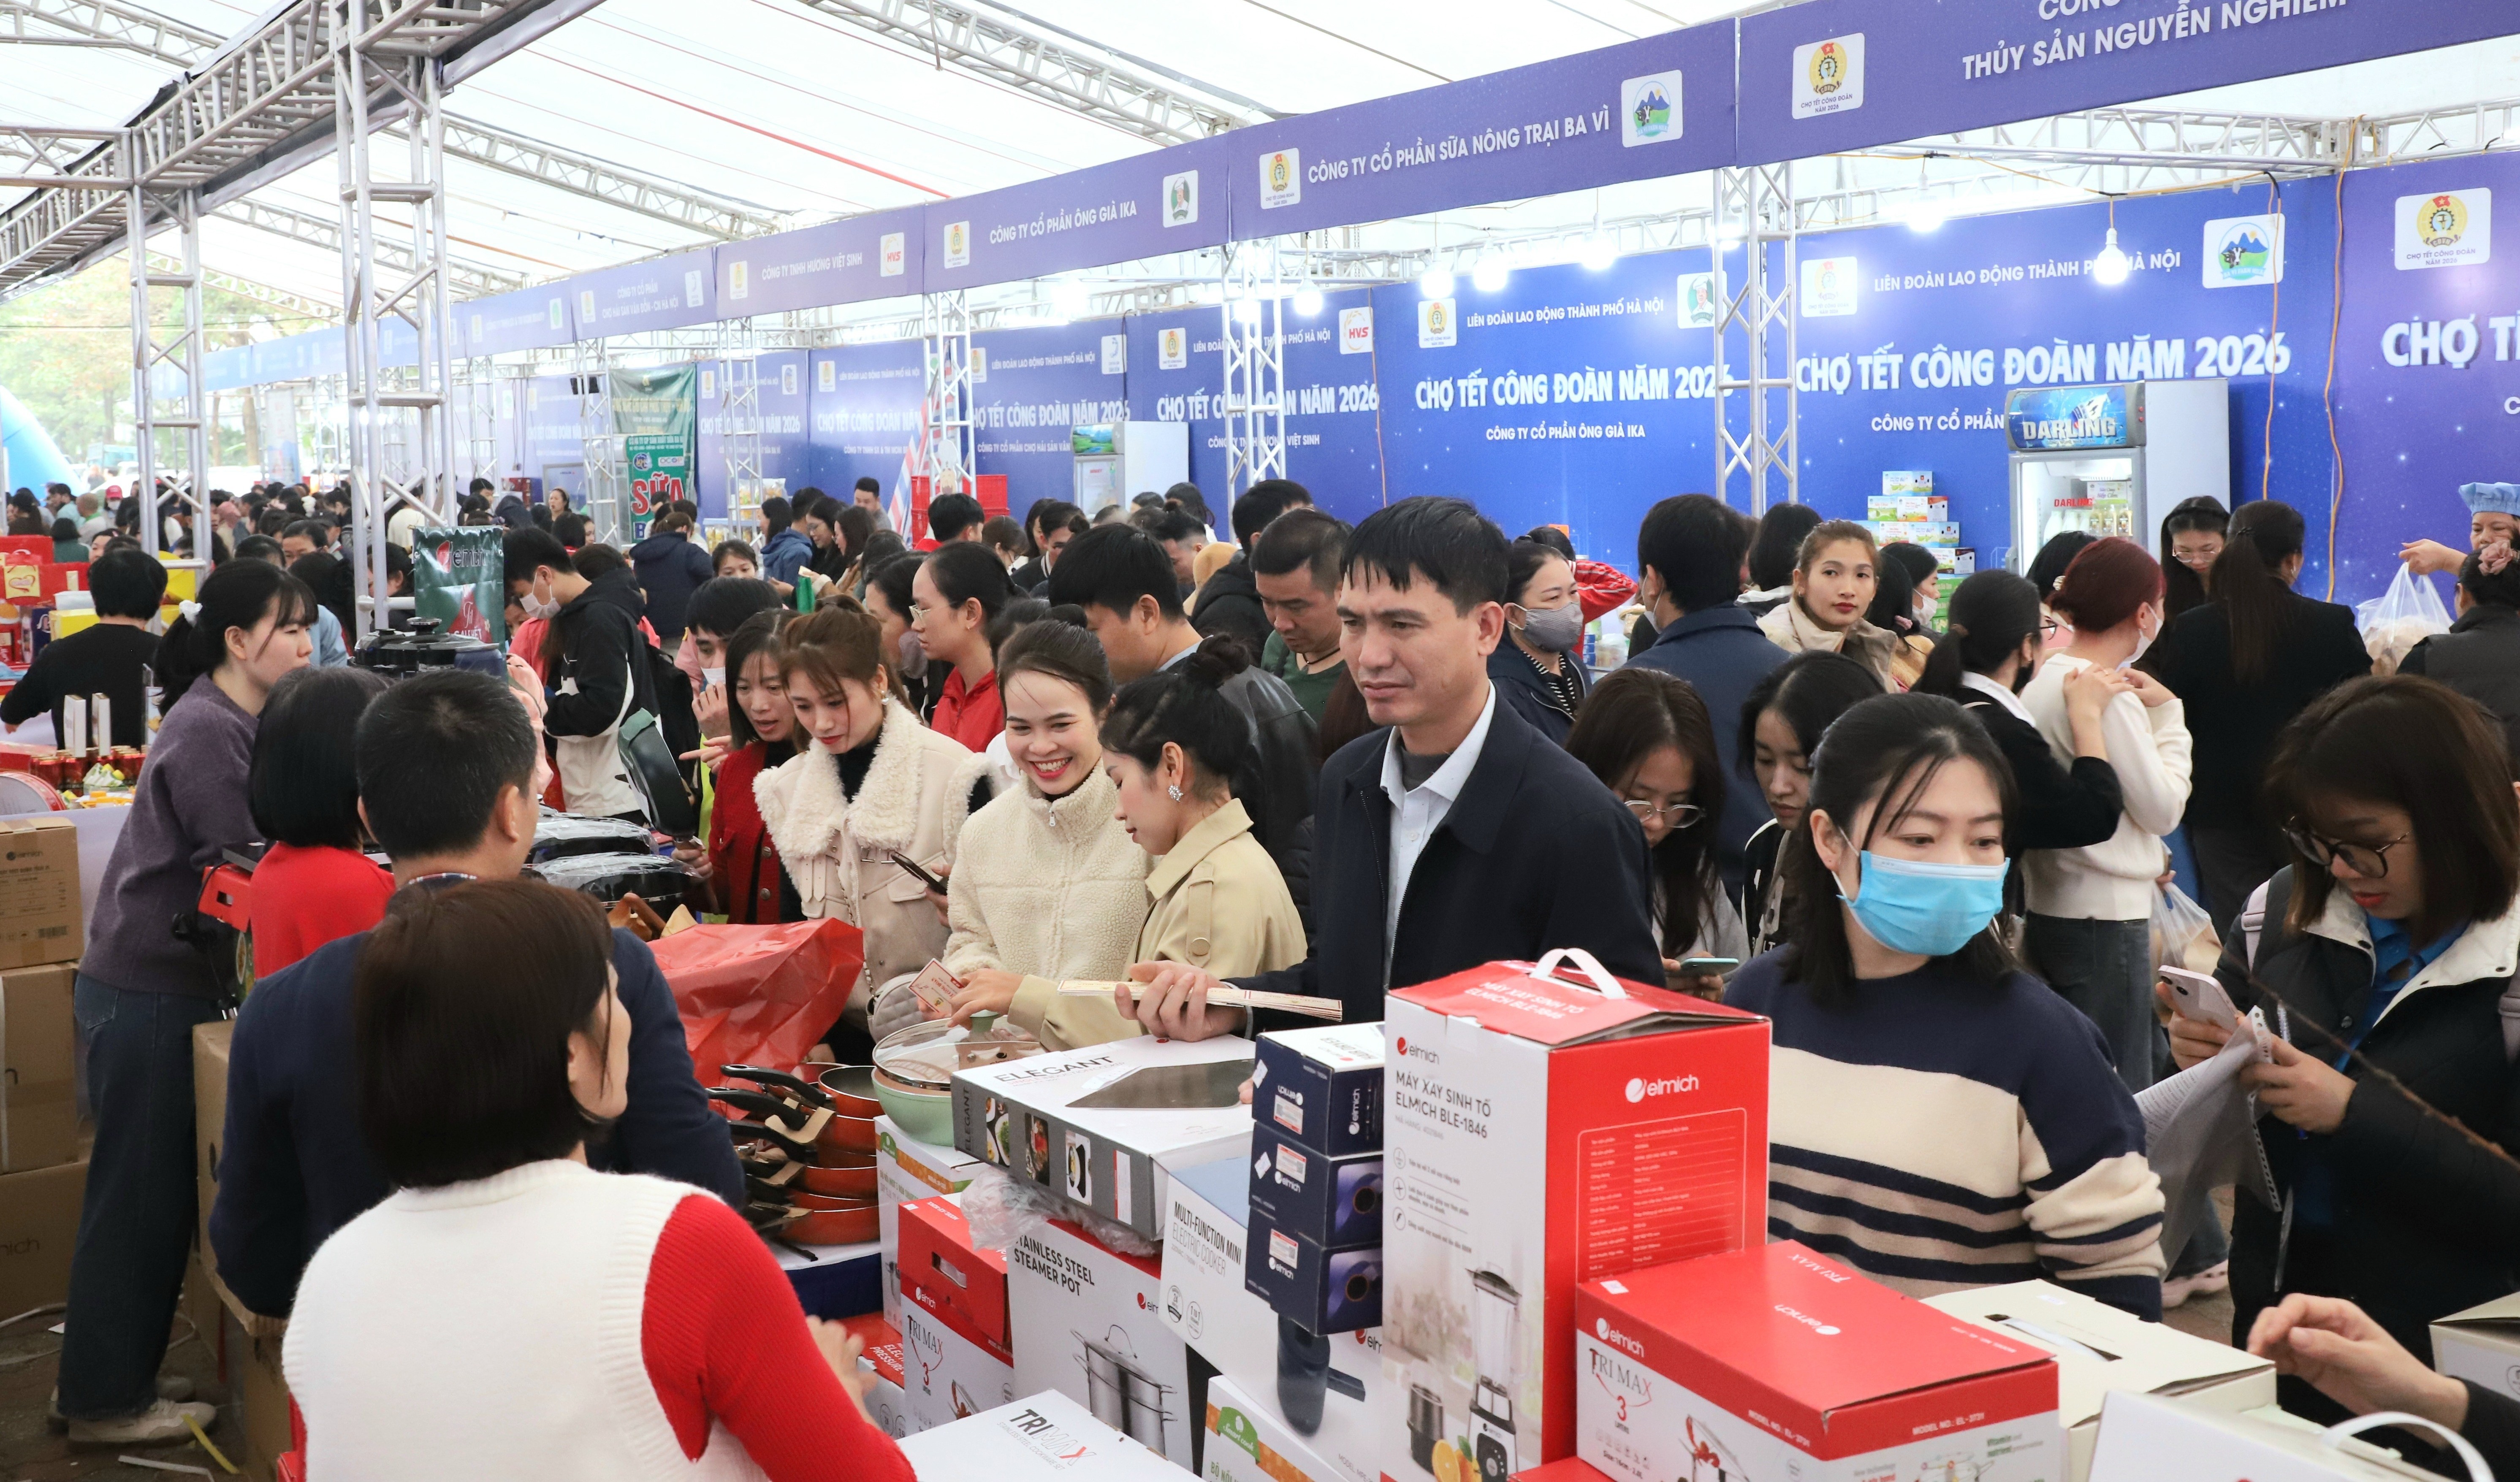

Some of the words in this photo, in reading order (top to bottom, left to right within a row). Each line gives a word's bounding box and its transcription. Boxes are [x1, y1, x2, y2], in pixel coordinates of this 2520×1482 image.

[1962, 40, 2026, 80] THỦY
[2033, 28, 2085, 66] SẢN
[2095, 0, 2210, 55] NGUYỄN
[1308, 159, 1348, 183] CÔNG
[1351, 156, 1366, 176] TY
[1370, 141, 1392, 173] CỔ
[1396, 136, 1435, 168] PHẦN
[1439, 135, 1469, 160] SỮA
[1473, 127, 1520, 155] NÔNG
[1524, 119, 1560, 147] TRẠI
[1564, 114, 1587, 138] BA
[1592, 104, 1609, 132] VÌ
[990, 225, 1016, 244] CÔNG
[1018, 223, 1028, 239] TY
[1030, 212, 1044, 236] CỔ
[1047, 208, 1072, 233] PHẦN
[1074, 208, 1097, 228] ÔNG
[1099, 200, 1118, 222] GIÀ
[1120, 200, 1137, 219] IKA
[762, 265, 780, 280] CÔNG
[781, 265, 788, 277] TY
[789, 262, 806, 276] TNHH
[846, 252, 862, 266] SINH
[887, 251, 901, 263] HVS
[1874, 274, 1900, 292] LIÊN
[1904, 271, 1944, 290] ĐOÀN
[1948, 270, 1975, 286] LAO
[1980, 264, 2024, 286] ĐỘNG
[2028, 259, 2079, 279] THÀNH
[2151, 248, 2181, 272] NỘI
[1467, 312, 1485, 328] LIÊN
[1486, 307, 1514, 325] ĐOÀN
[1516, 309, 1534, 324] LAO
[1535, 305, 1565, 323] ĐỘNG
[1567, 303, 1600, 319] THÀNH
[1603, 297, 1625, 316] PHỐ
[1627, 297, 1641, 314] HÀ
[1644, 296, 1664, 315] NỘI
[1305, 329, 1316, 342] HÀ
[1317, 328, 1331, 344] NỘI
[1349, 327, 1369, 339] HVS
[2382, 314, 2479, 369] CHỢ
[992, 359, 1002, 370] LIÊN
[1018, 358, 1028, 368] LAO
[1076, 352, 1084, 363] HÀ
[1796, 353, 1851, 395] CHỢ
[1858, 341, 1903, 390] TẾT
[1911, 344, 1994, 389] CÔNG
[2002, 337, 2095, 385] ĐOÀN
[2105, 333, 2185, 381] NĂM
[2195, 332, 2291, 378] 2026
[1415, 376, 1454, 412] CHỢ
[1457, 368, 1489, 408] TẾT
[1492, 369, 1548, 405] CÔNG
[1553, 365, 1613, 404] ĐOÀN
[1619, 363, 1670, 401] NĂM
[988, 400, 1005, 428] TẾT
[1007, 401, 1036, 428] CÔNG
[1039, 400, 1070, 426] ĐOÀN
[1072, 398, 1098, 424] NĂM
[1156, 394, 1185, 422] CHỢ
[1187, 387, 1210, 420] TẾT
[1300, 385, 1335, 415] NĂM
[1338, 383, 1379, 413] 2026
[817, 410, 834, 434] CHỢ
[835, 408, 849, 432] TẾT
[851, 408, 874, 432] CÔNG
[876, 408, 900, 431] ĐOÀN
[1486, 425, 1515, 441] CÔNG
[1517, 427, 1529, 440] TY
[1531, 420, 1546, 440] CỔ
[1549, 419, 1576, 439] PHẦN
[1579, 423, 1603, 439] ÔNG
[1605, 422, 1625, 439] GIÀ
[1628, 423, 1646, 438] IKA
[1872, 413, 1914, 431] CÔNG
[1918, 416, 1933, 431] TY
[1937, 408, 1960, 430] CỔ
[1964, 407, 2004, 430] PHẦN
[2023, 417, 2117, 440] DARLING
[1286, 433, 1301, 448] VIỆT
[1302, 434, 1320, 445] SINH
[631, 471, 685, 515] SỮA
[2054, 498, 2093, 507] DARLING
[993, 1056, 1114, 1082] ELEGANT
[1409, 1045, 1440, 1065] elmich
[1396, 1070, 1419, 1090] MÁY
[1422, 1079, 1443, 1099] XAY
[1446, 1088, 1472, 1111] SINH
[1476, 1098, 1491, 1117] TỐ
[1647, 1074, 1699, 1097] elmich
[963, 1087, 971, 1151] ELEGANT
[1352, 1088, 1360, 1121] elmich
[1396, 1091, 1437, 1119] ELMICH
[1440, 1108, 1487, 1139] BLE-1846
[1281, 1176, 1301, 1193] elmich
[1174, 1201, 1225, 1253] MULTI-FUNCTION
[1226, 1239, 1242, 1265] MINI
[1173, 1222, 1200, 1257] ELECTRIC
[1202, 1244, 1226, 1277] COOKER
[1014, 1248, 1059, 1284] STEAMER
[1061, 1273, 1081, 1296] POT
[1065, 1257, 1095, 1286] STEEL
[1275, 1262, 1294, 1280] elmich
[921, 1293, 936, 1309] elmich
[907, 1314, 921, 1341] TRI
[923, 1328, 943, 1355] MAX
[1609, 1329, 1644, 1358] elmich
[923, 1362, 929, 1386] 3
[1590, 1348, 1613, 1379] TRI
[1617, 1364, 1652, 1396] MAX
[1617, 1395, 1627, 1421] 3
[1009, 1409, 1097, 1466] TRIMAX
[1223, 1422, 1241, 1441] Smart
[1241, 1438, 1254, 1452] cook
[1211, 1461, 1220, 1477] BỘ
